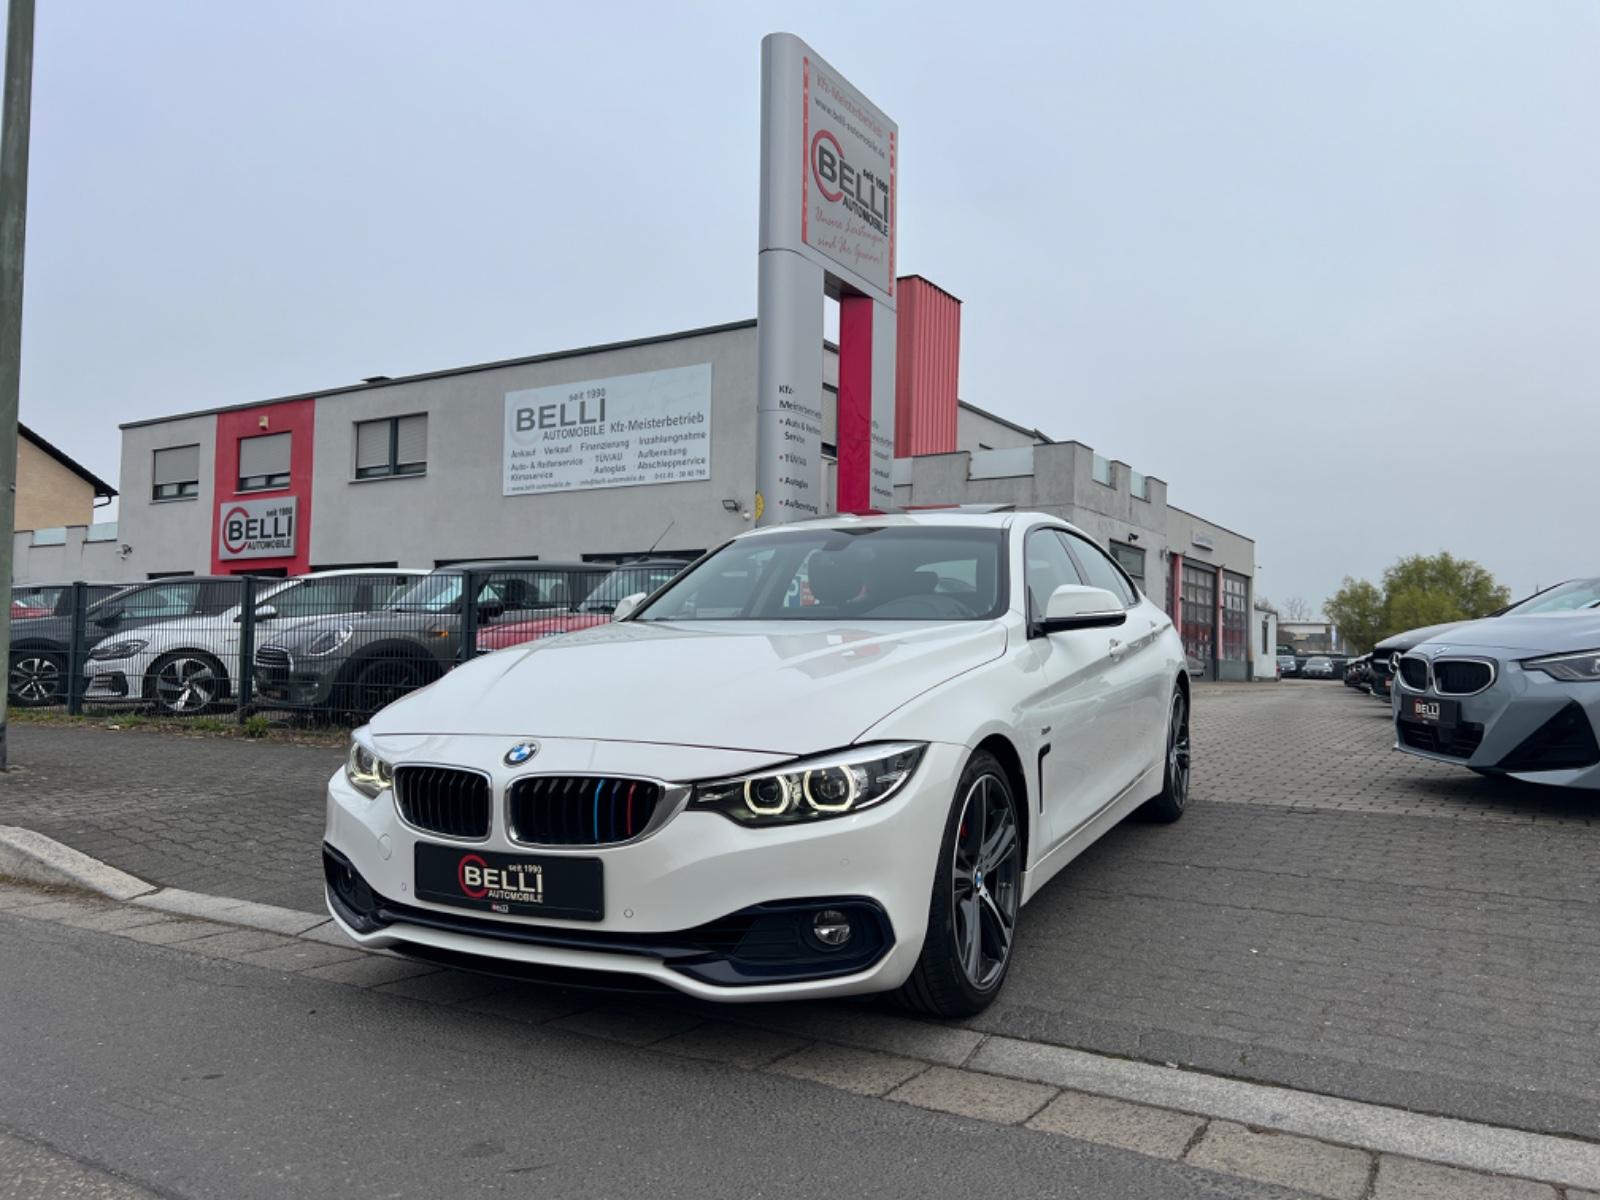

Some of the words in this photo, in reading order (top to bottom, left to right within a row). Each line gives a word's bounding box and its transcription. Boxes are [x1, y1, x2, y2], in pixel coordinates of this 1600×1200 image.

[819, 145, 888, 223] BELLI
[863, 169, 874, 184] seit
[842, 195, 888, 237] AUTOMOBILE
[569, 391, 584, 401] seit
[516, 398, 605, 432] BELLI
[610, 411, 704, 433] Kfz-Meisterbetrieb
[542, 424, 605, 441] AUTOMOBILE
[511, 448, 536, 458] Ankauf
[544, 444, 572, 455] Verkauf
[580, 440, 630, 452] Finanzierung
[639, 431, 706, 446] Inzahlungnahme
[638, 447, 688, 459] Aufbereitung
[594, 464, 627, 475] Autoglas
[638, 457, 706, 470] Abschleppservice
[266, 508, 277, 517] seit
[228, 516, 292, 541] BELLI
[247, 539, 291, 550] AUTOMOBILE
[508, 864, 522, 872] seit
[464, 866, 543, 893] BELLI
[488, 889, 543, 903] AUTOMOBILE
